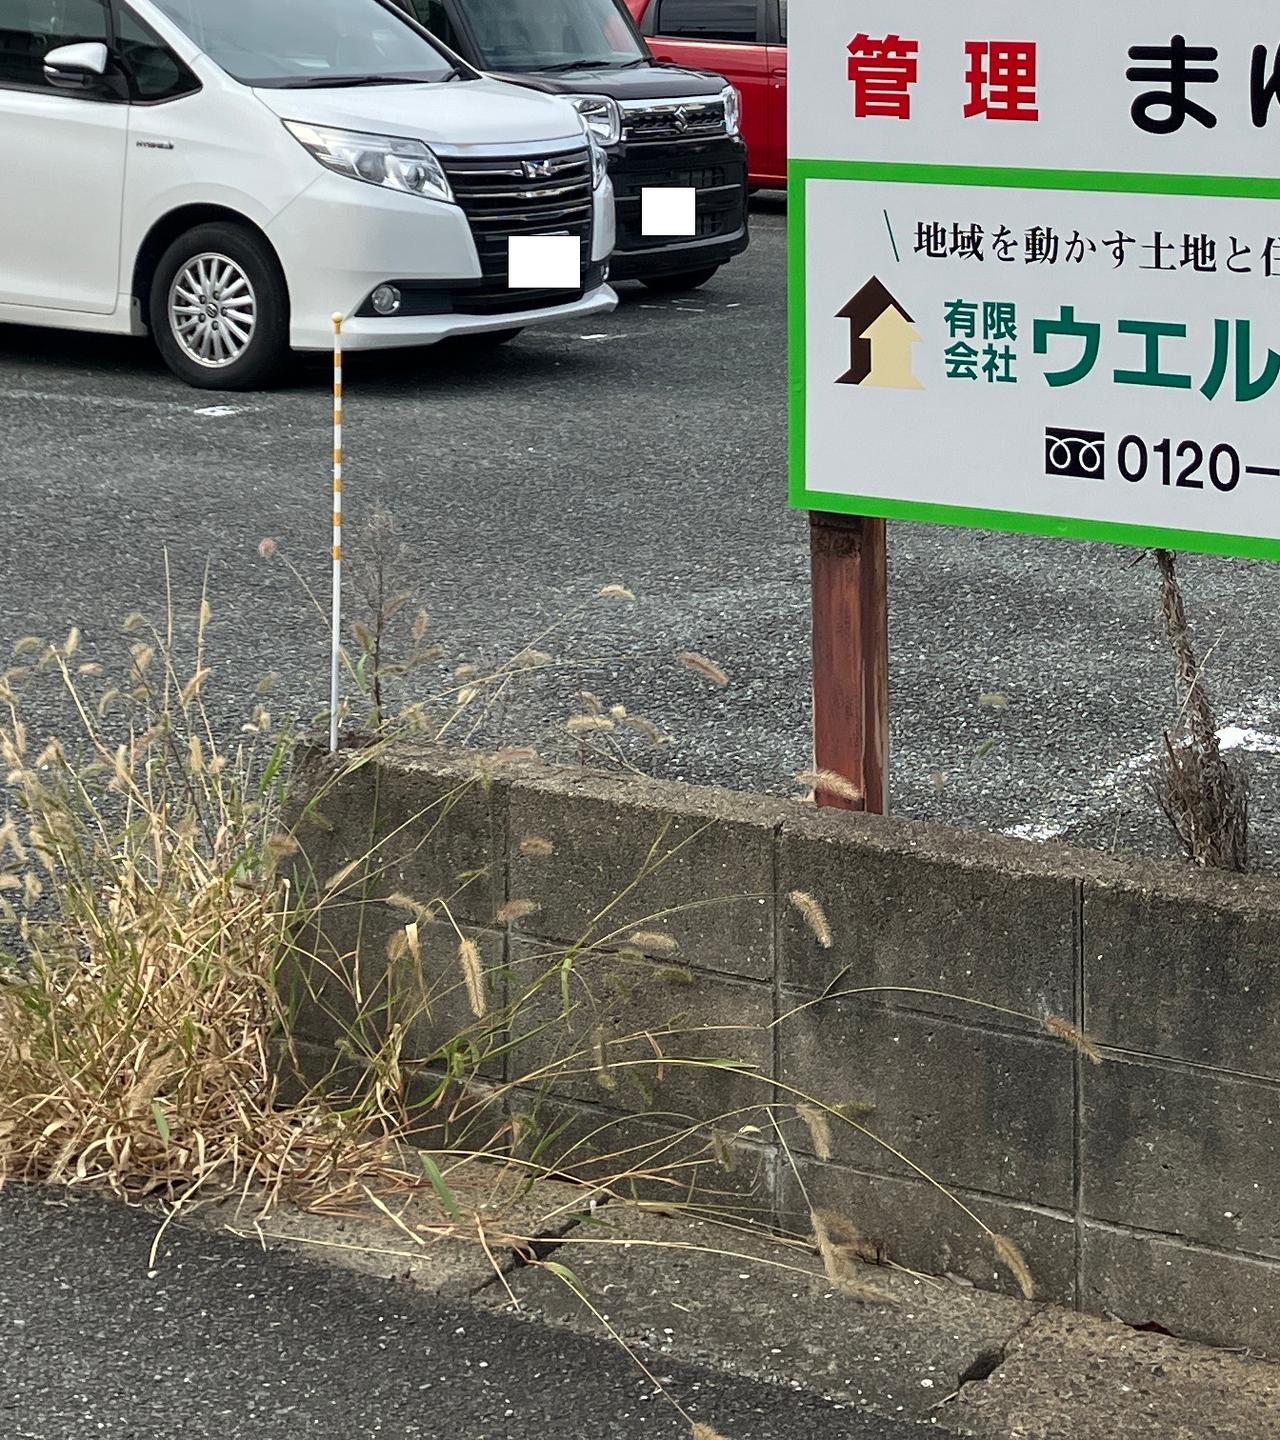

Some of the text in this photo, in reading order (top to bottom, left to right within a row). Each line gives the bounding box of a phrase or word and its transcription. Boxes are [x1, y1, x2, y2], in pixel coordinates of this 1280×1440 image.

[847, 33, 1039, 122] 管理
[943, 298, 1018, 341] 有限
[943, 341, 1018, 384] 会社
